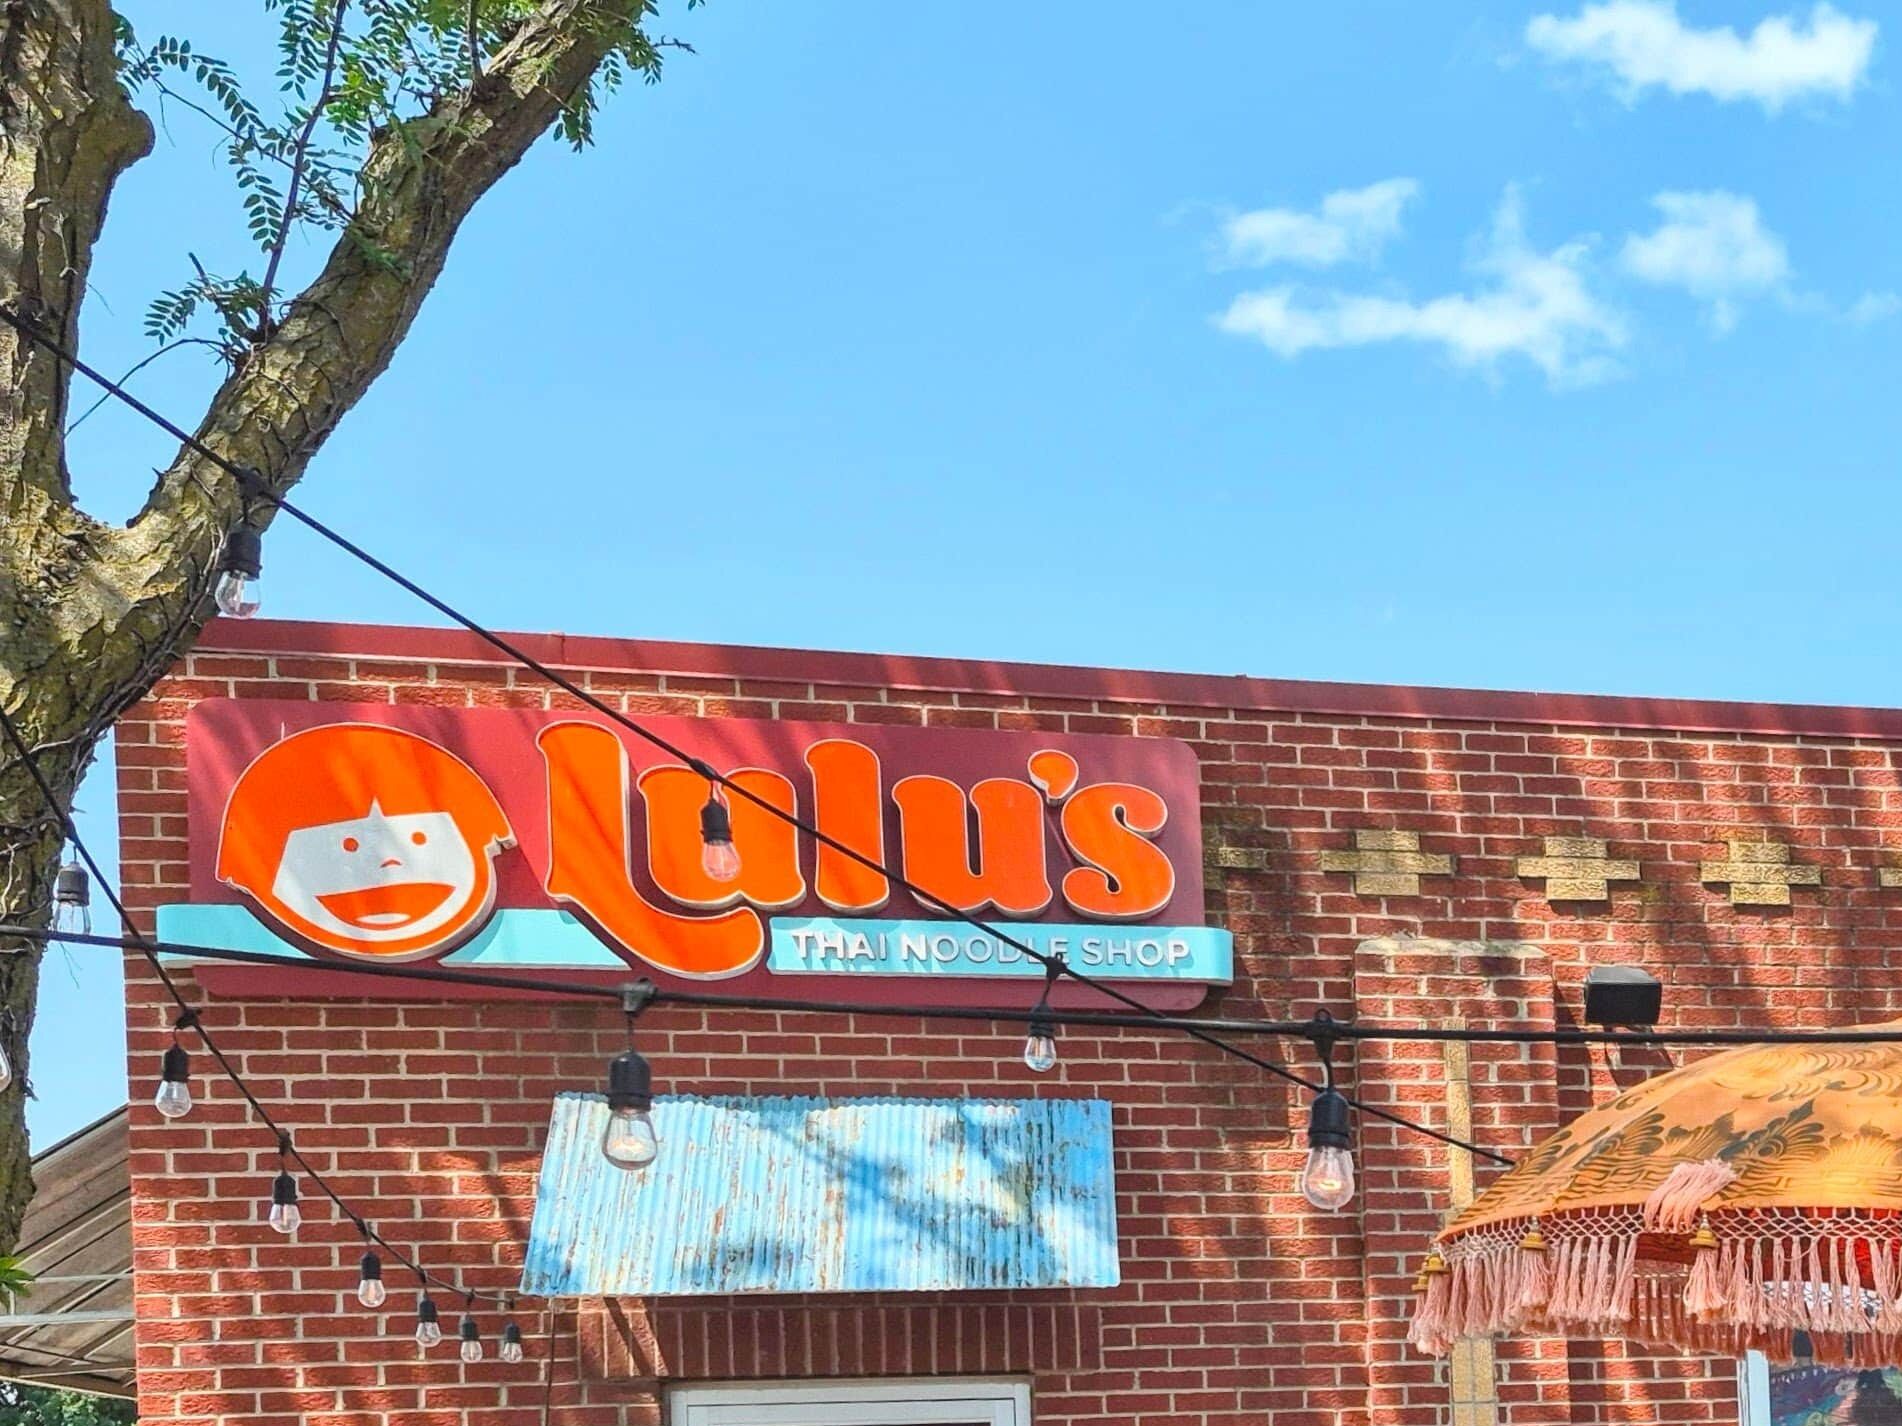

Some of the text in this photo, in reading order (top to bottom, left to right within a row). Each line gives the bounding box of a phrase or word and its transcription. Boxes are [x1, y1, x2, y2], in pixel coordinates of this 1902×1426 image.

[536, 719, 1176, 980] Lulu's
[791, 930, 1191, 968] THAI NOODLE SHOP
